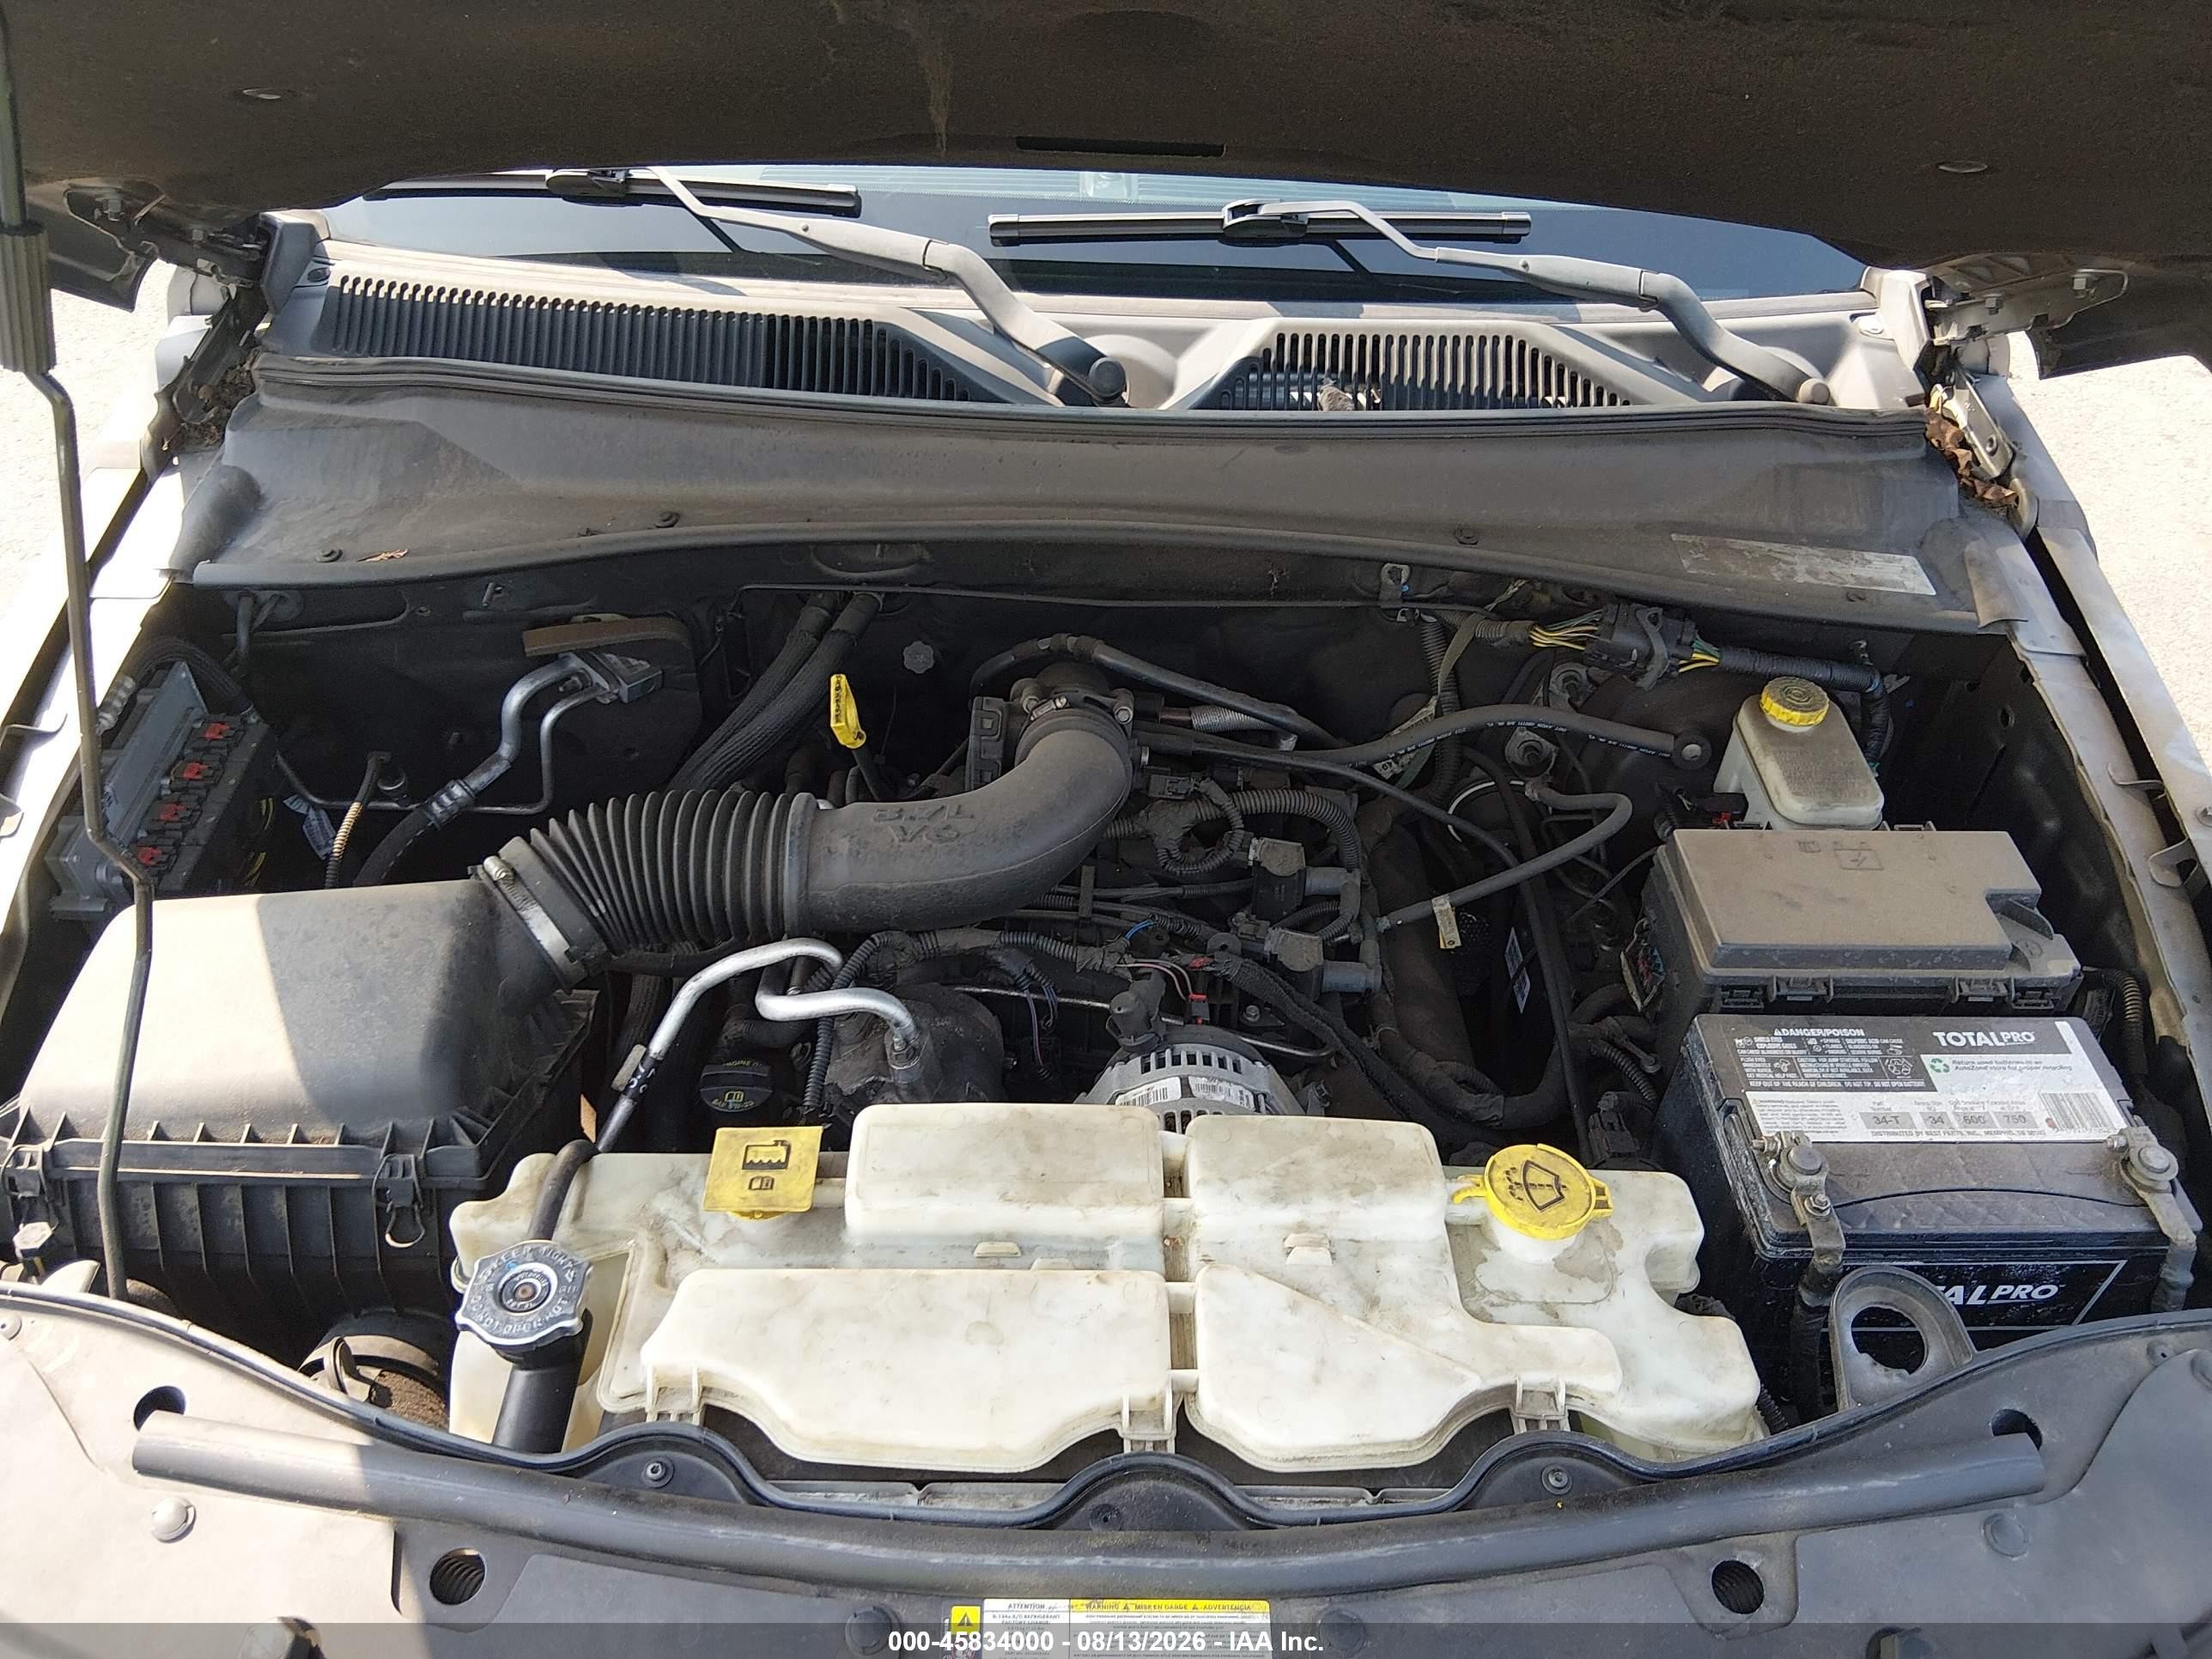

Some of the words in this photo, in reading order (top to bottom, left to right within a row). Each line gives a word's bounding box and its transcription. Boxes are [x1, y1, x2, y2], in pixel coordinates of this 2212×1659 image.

[888, 824, 962, 845] V6
[1781, 1029, 1865, 1037] DANGER/POISON
[1932, 1030, 2037, 1048] TOTALPRO
[711, 1098, 728, 1108] SAE
[1872, 1115, 1899, 1125] 34-T
[1928, 1115, 1944, 1125] 34
[1963, 1115, 1986, 1125] 600
[2002, 1115, 2027, 1124] 750
[1936, 1284, 2059, 1305] ALPRO
[1085, 1601, 1120, 1610] WARNING
